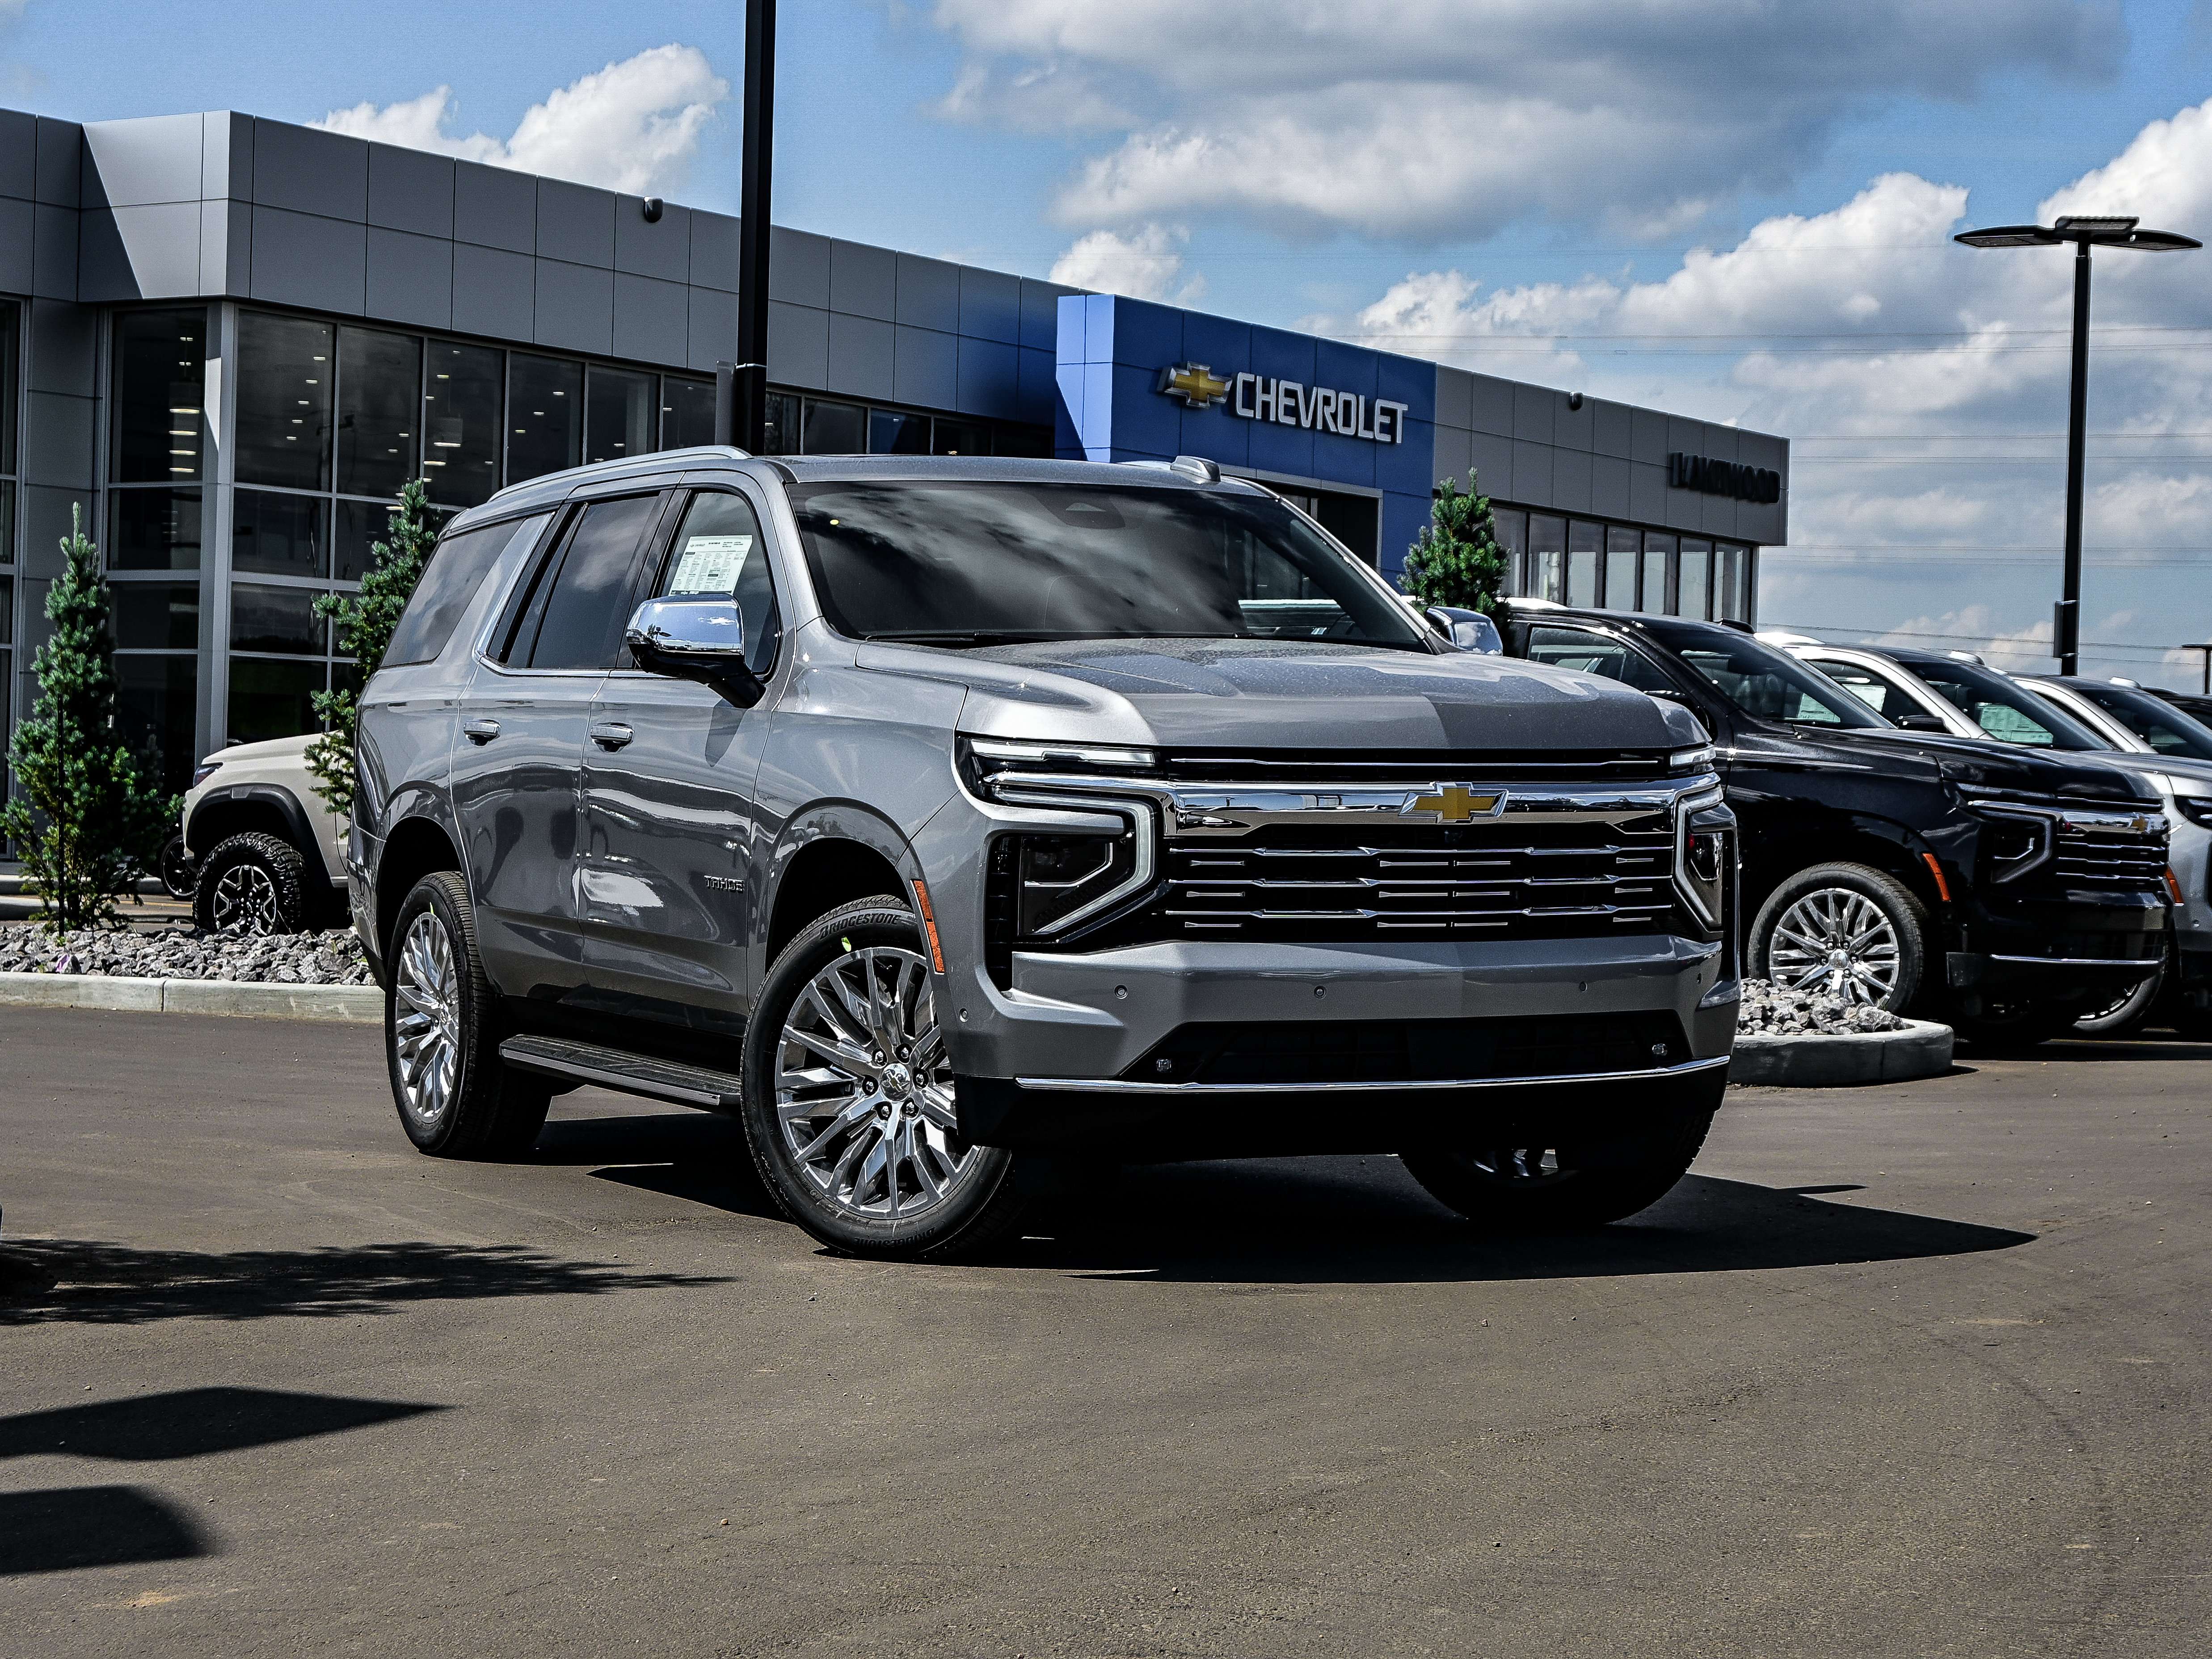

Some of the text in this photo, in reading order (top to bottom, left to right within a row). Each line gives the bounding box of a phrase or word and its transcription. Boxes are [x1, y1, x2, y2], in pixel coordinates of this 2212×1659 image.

[1236, 372, 1408, 443] CHEVROLET
[704, 875, 744, 893] TAHOE
[820, 913, 902, 939] BRIDGESTONE
